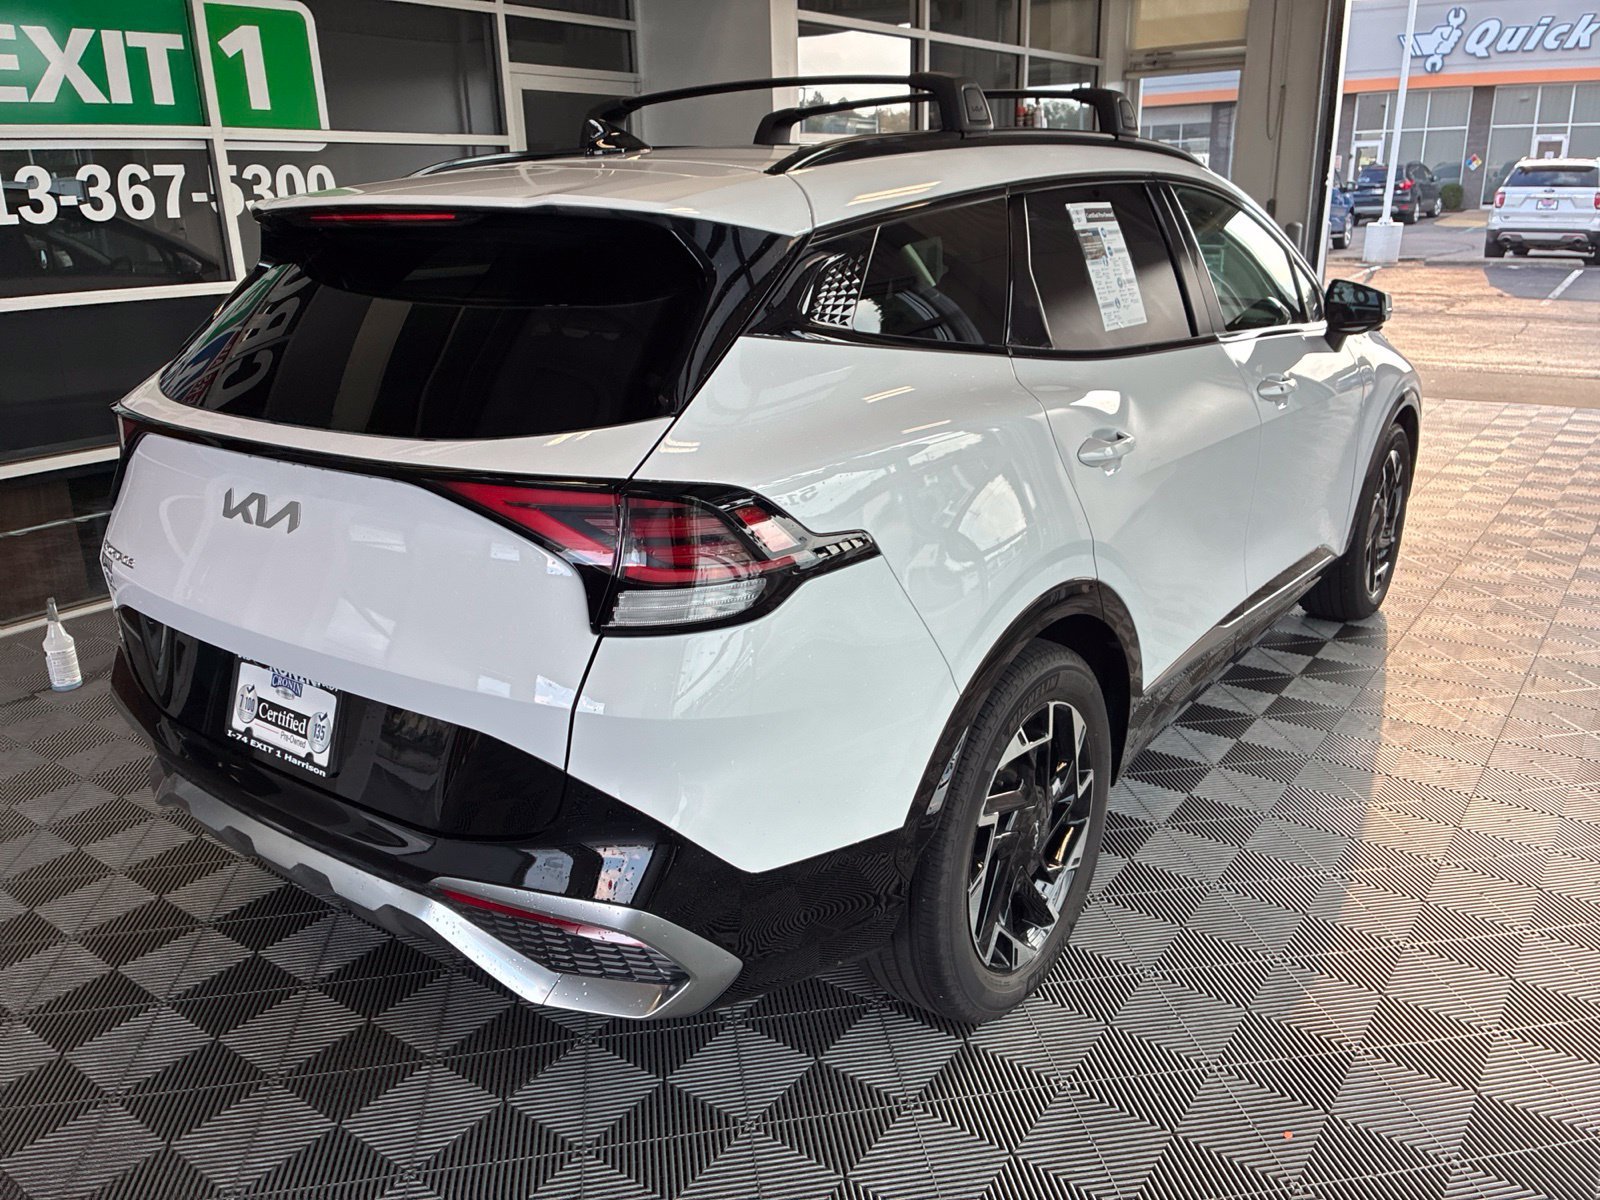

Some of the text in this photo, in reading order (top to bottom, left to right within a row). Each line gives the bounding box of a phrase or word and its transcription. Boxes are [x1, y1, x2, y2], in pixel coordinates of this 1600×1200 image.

[1464, 13, 1600, 58] Quick
[217, 25, 271, 110] 1
[222, 487, 302, 534] KIA
[272, 673, 303, 698] CRONIN
[258, 702, 307, 735] Certified
[313, 723, 326, 741] 135
[227, 729, 327, 777] I-74 EXIT 1 Harrison
[280, 731, 307, 749] Pre-Owned
